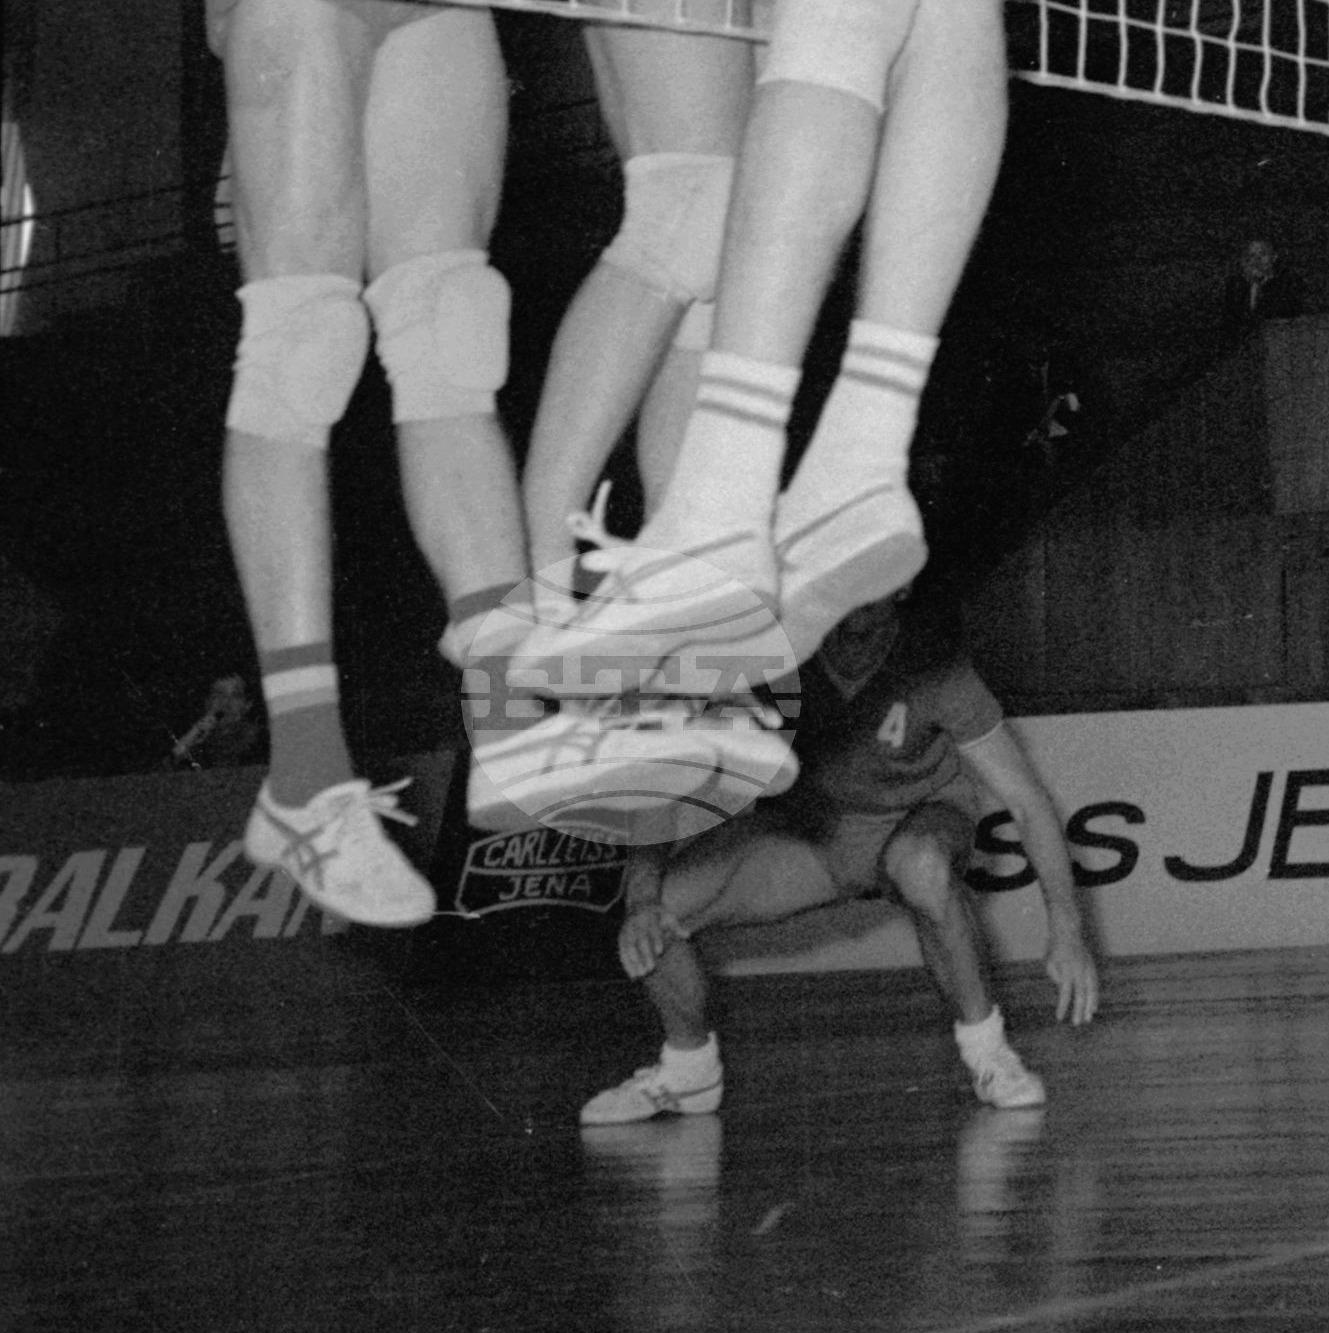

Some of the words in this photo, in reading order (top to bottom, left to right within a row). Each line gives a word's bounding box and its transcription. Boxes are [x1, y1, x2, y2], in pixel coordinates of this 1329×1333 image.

[877, 702, 908, 748] 4
[484, 831, 548, 866] CARL
[499, 874, 591, 900] JENA
